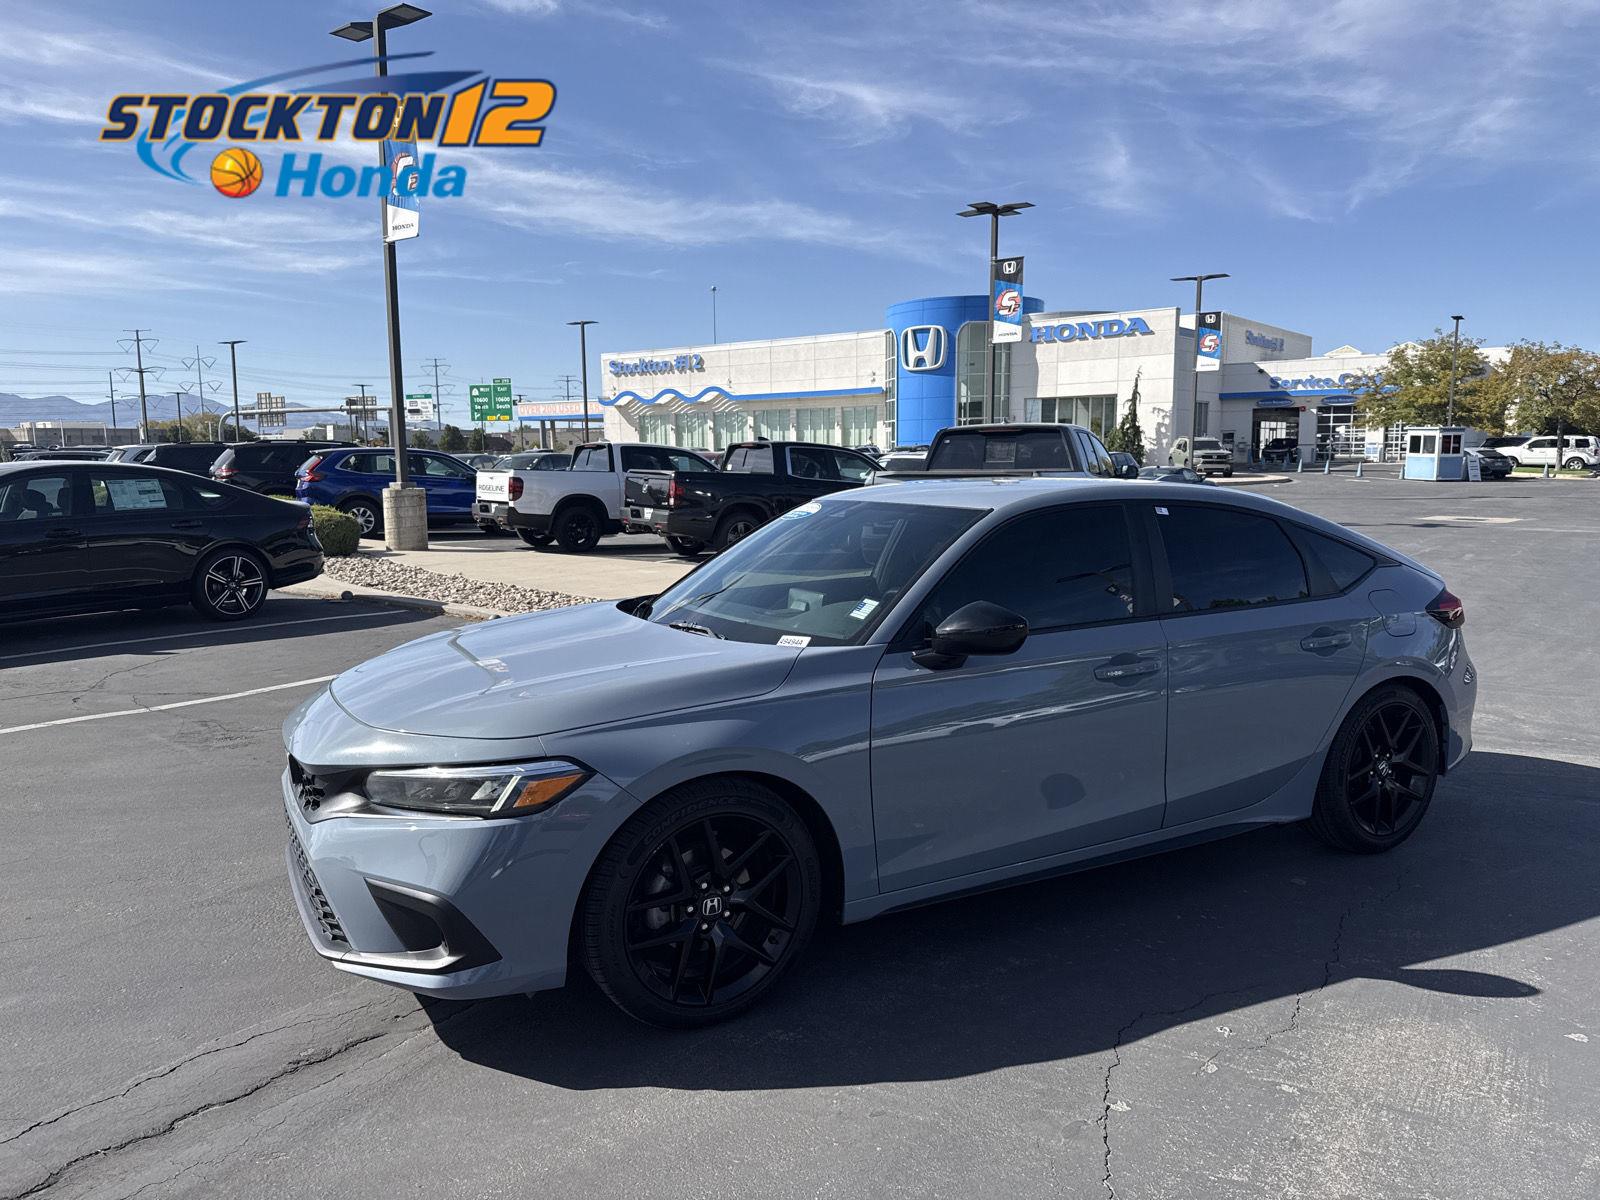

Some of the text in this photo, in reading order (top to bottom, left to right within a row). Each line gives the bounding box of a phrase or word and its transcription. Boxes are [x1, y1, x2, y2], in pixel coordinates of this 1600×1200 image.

[391, 223, 415, 232] HONDA
[1030, 317, 1153, 343] HONDA
[609, 358, 670, 375] Stockton
[1270, 374, 1337, 389] Service
